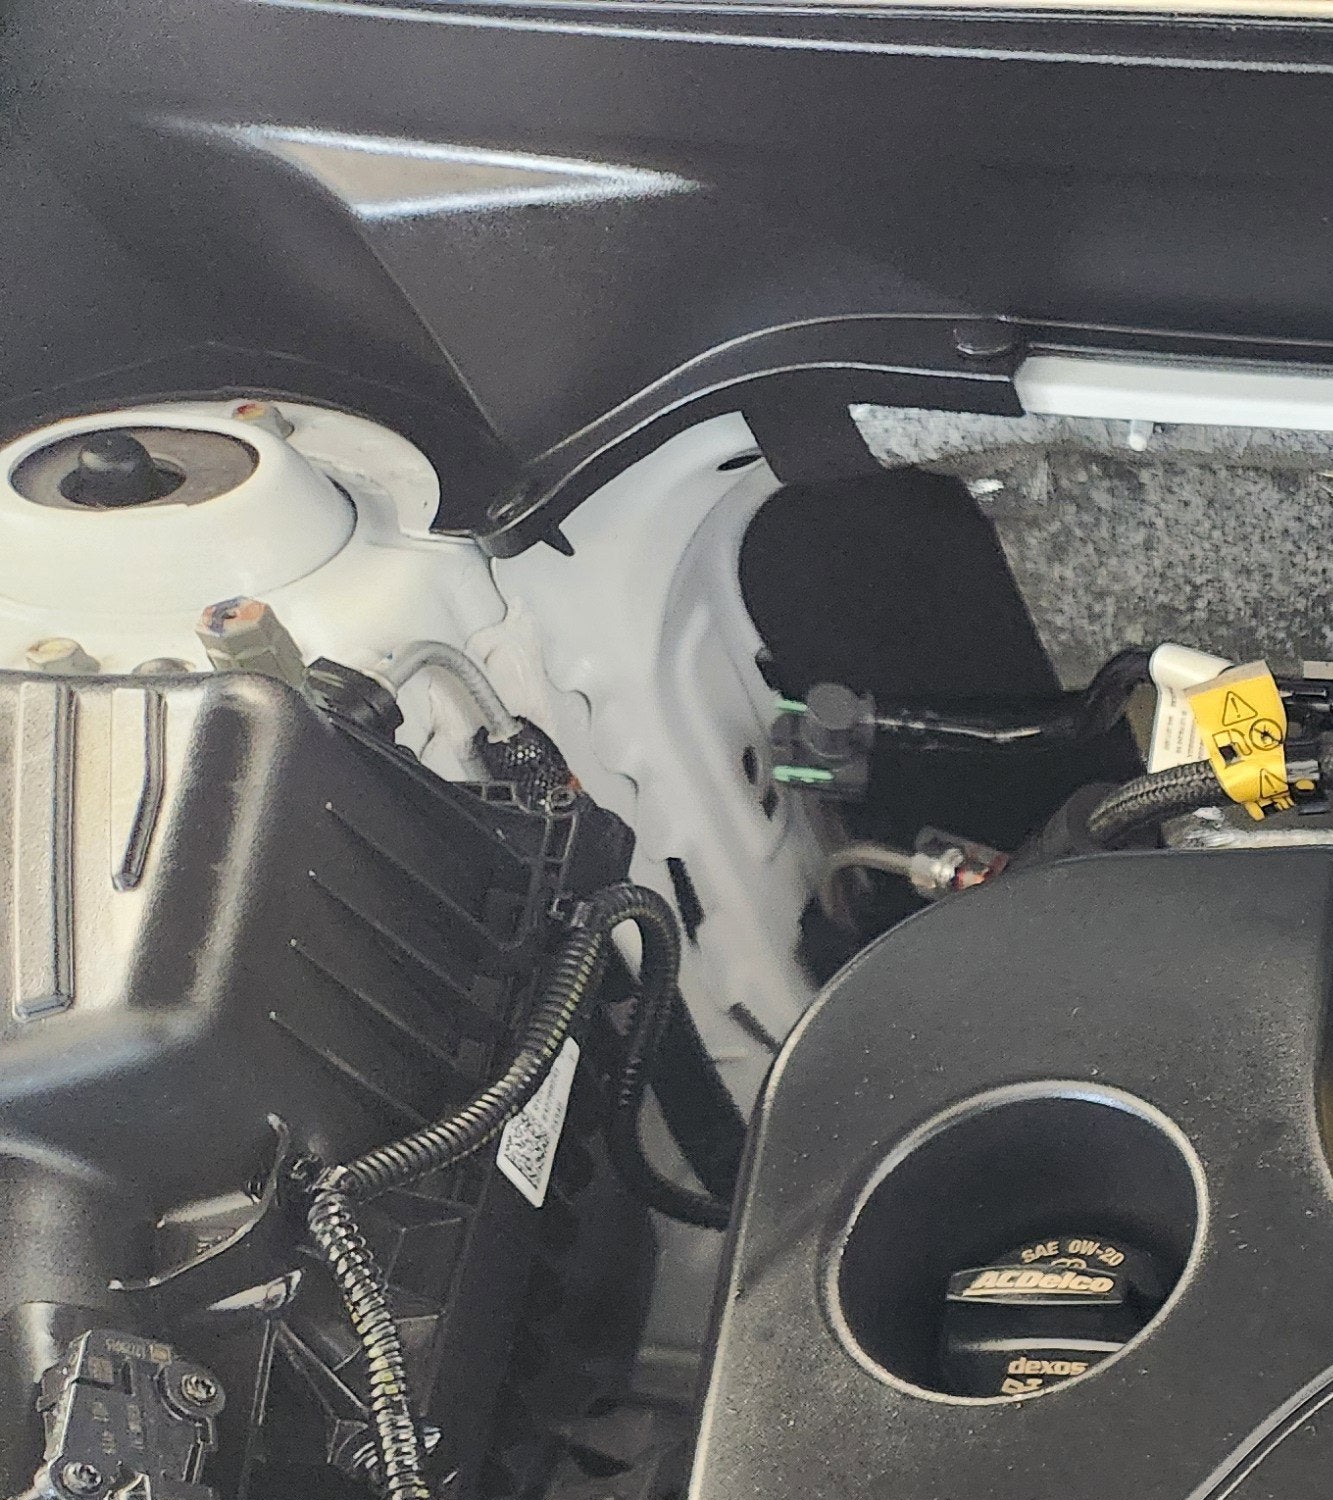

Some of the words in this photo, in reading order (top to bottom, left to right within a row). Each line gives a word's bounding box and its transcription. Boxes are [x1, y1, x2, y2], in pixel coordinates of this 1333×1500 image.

[1021, 1240, 1060, 1264] SAE
[1068, 1238, 1125, 1267] 0W-20
[970, 1270, 1115, 1294] ACDelco
[1007, 1357, 1089, 1376] dexos
